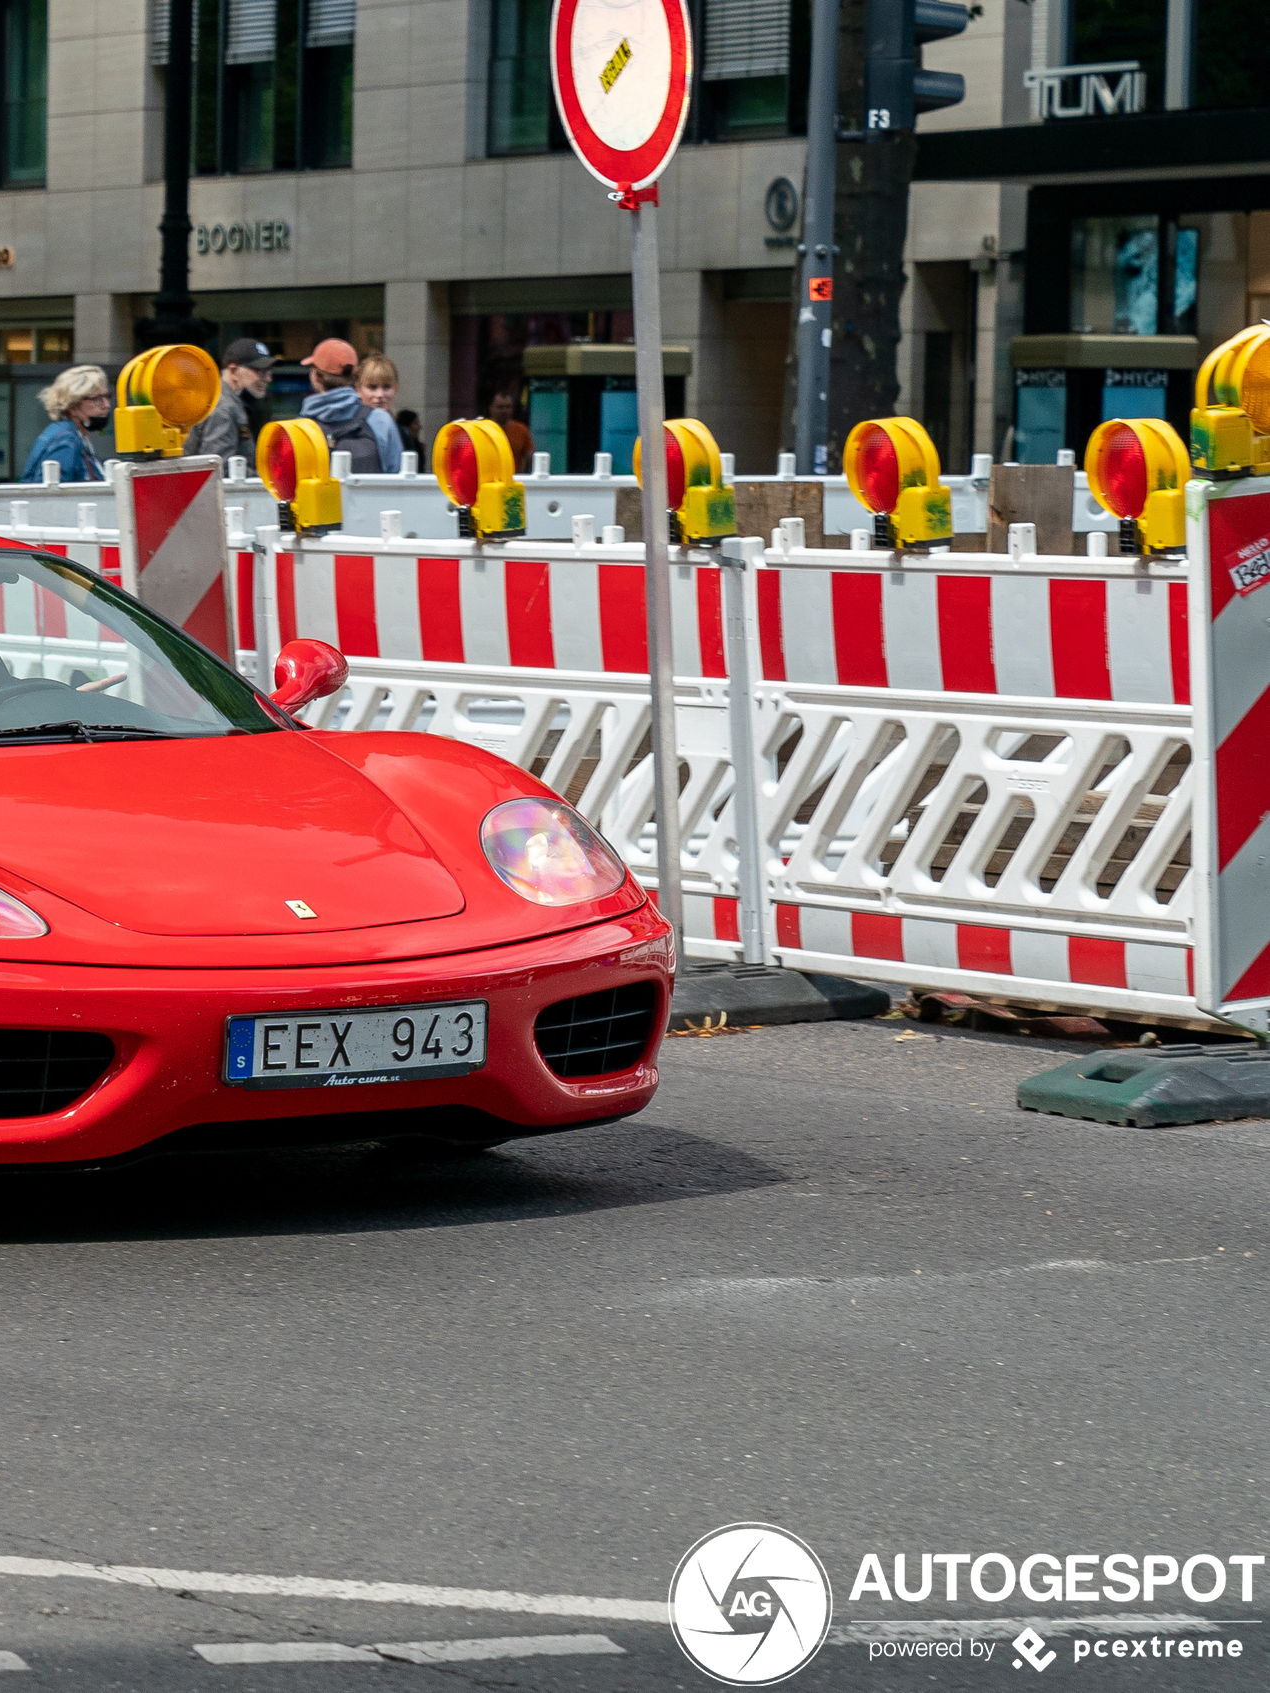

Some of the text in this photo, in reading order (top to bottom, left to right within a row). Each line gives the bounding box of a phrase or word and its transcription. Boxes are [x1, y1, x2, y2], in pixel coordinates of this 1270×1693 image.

[1023, 59, 1147, 119] TUMI
[868, 108, 891, 129] F3
[196, 220, 290, 253] BOGNER
[261, 1011, 476, 1071] EEX 943
[235, 1055, 246, 1069] S
